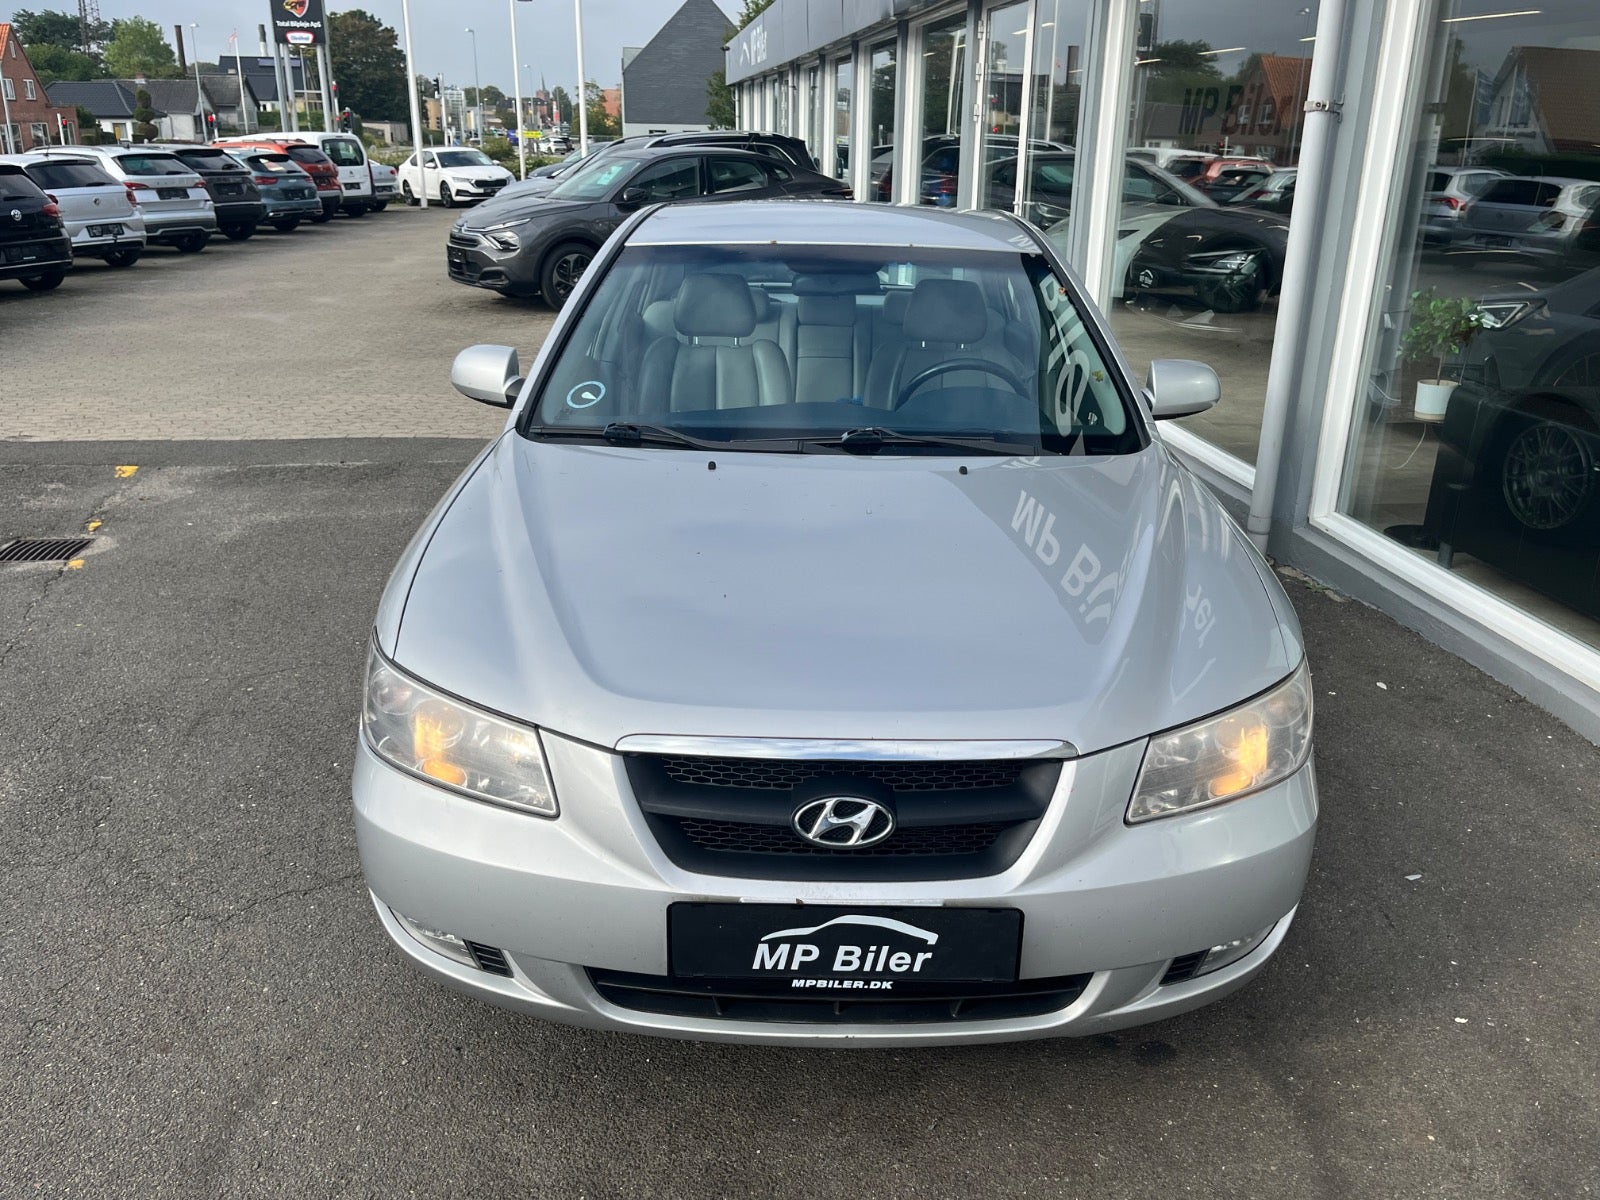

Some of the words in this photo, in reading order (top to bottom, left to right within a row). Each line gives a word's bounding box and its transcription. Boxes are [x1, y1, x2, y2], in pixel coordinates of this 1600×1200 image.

[1178, 87, 1219, 135] MP
[1220, 84, 1293, 136] Biler
[752, 943, 820, 971] MP
[832, 945, 933, 972] Biler
[791, 979, 894, 990] MPBILER.DK
